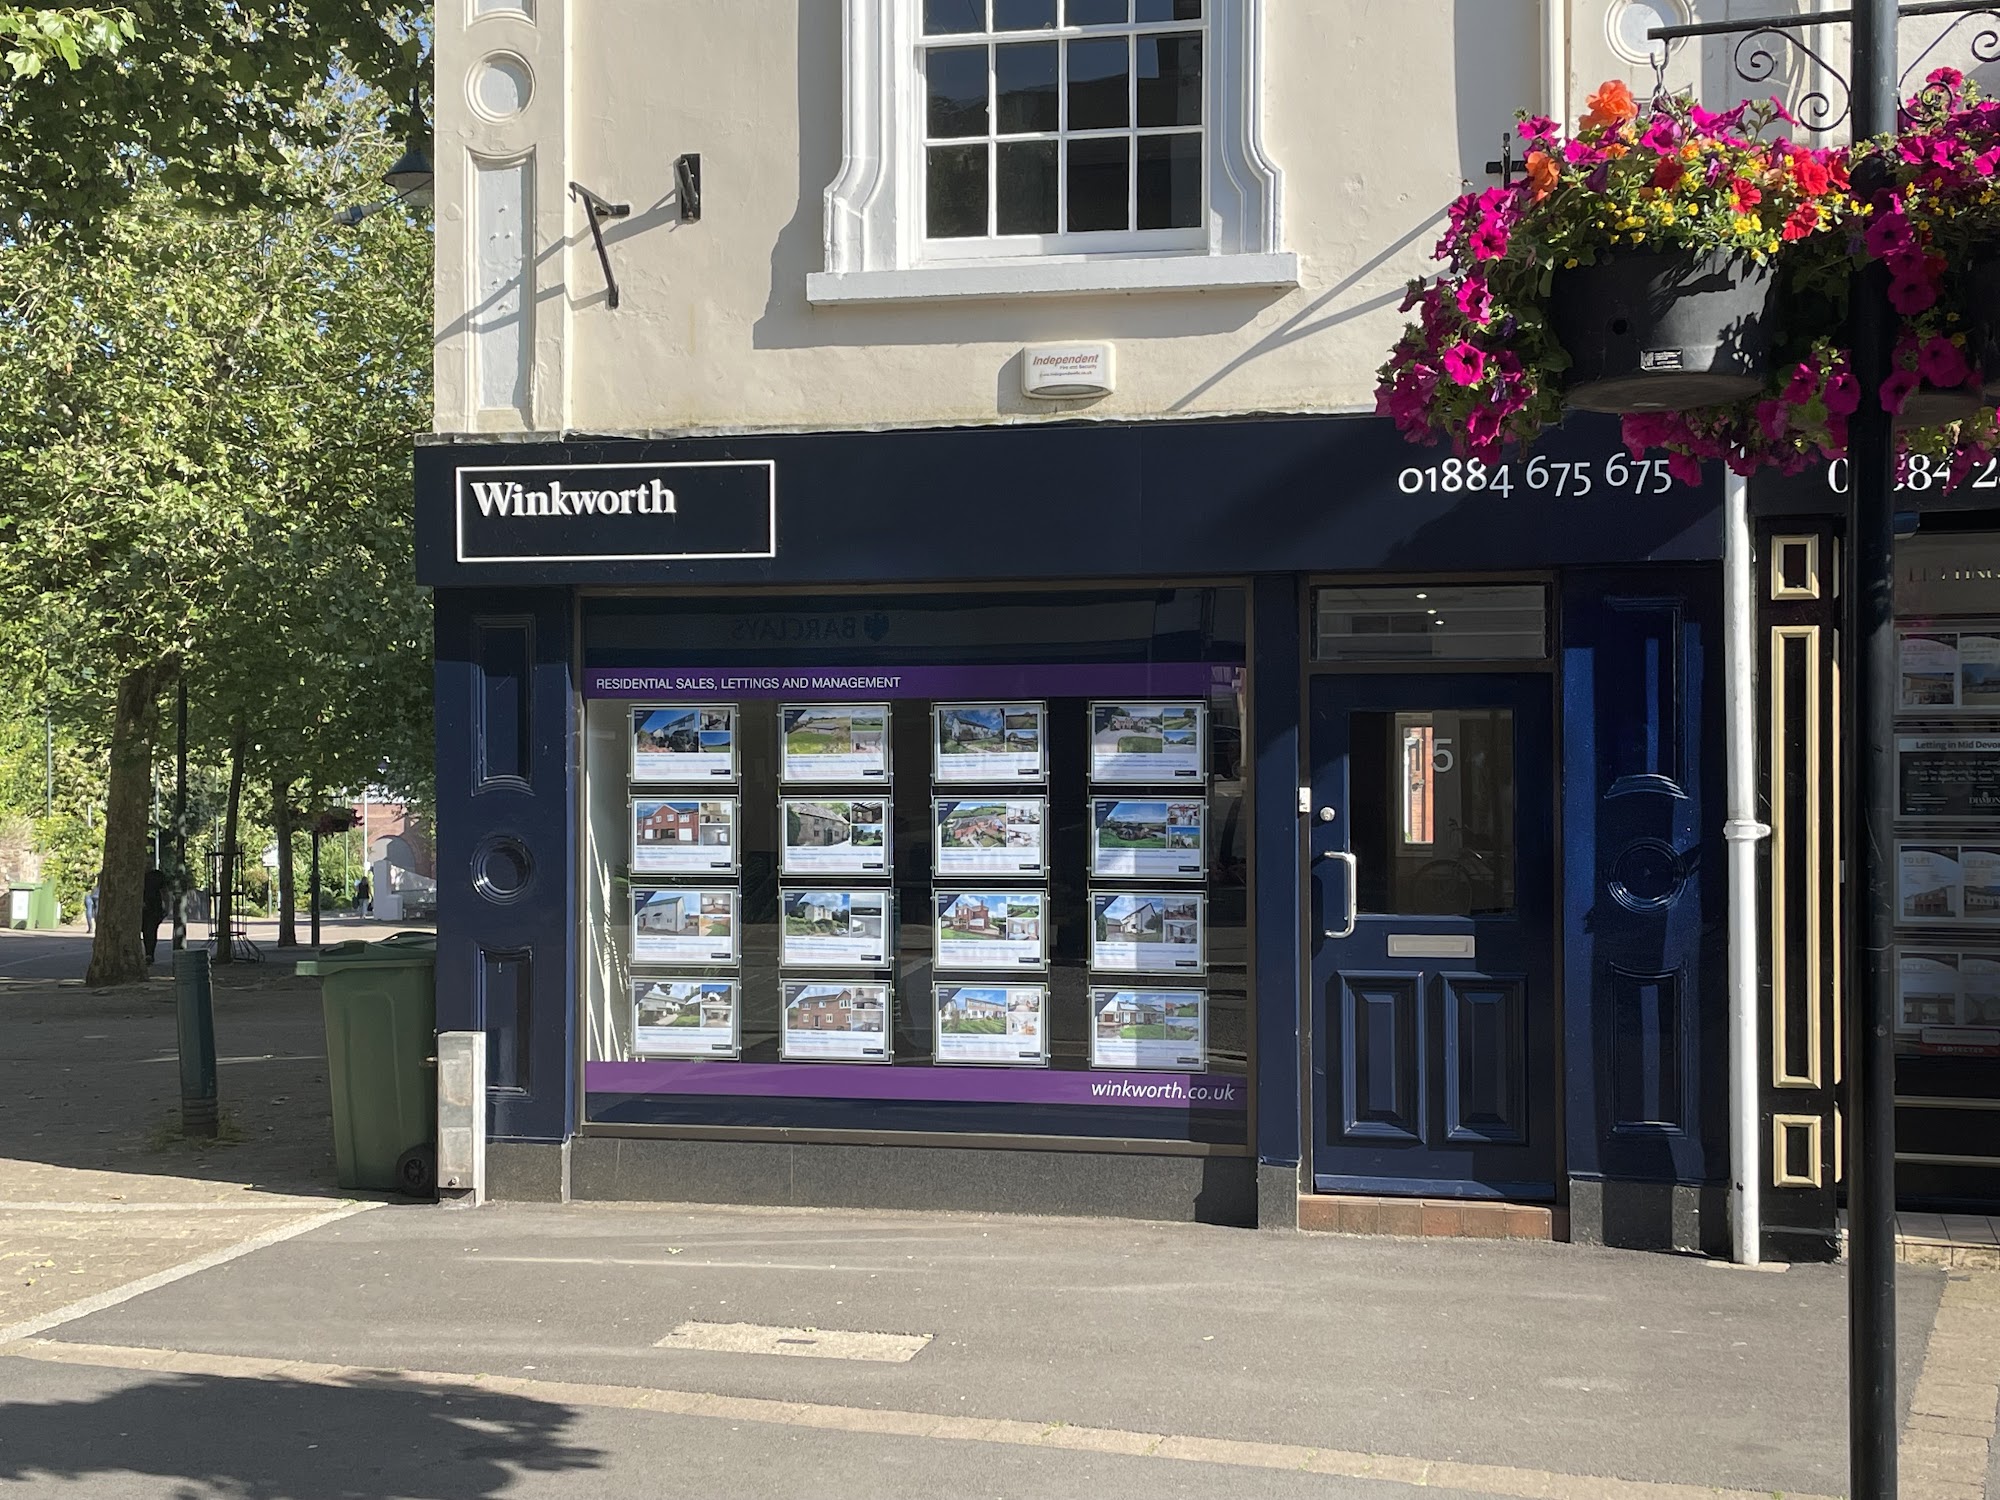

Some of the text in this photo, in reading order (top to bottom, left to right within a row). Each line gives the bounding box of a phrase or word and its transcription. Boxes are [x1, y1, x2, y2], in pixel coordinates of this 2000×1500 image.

[1033, 355, 1097, 366] Independent
[1398, 452, 1672, 498] 01884 675 675
[1828, 454, 2000, 493] 084 2
[470, 479, 676, 517] Winkworth
[596, 677, 901, 692] RESIDENTIAL SALES, LETTINGS AND MANAGEMENT
[1408, 738, 1454, 773] 15
[1916, 741, 1946, 751] Letting
[1947, 741, 1956, 749] in
[1958, 741, 1974, 749] Mid
[1091, 1079, 1235, 1101] winkworth.co.uk
